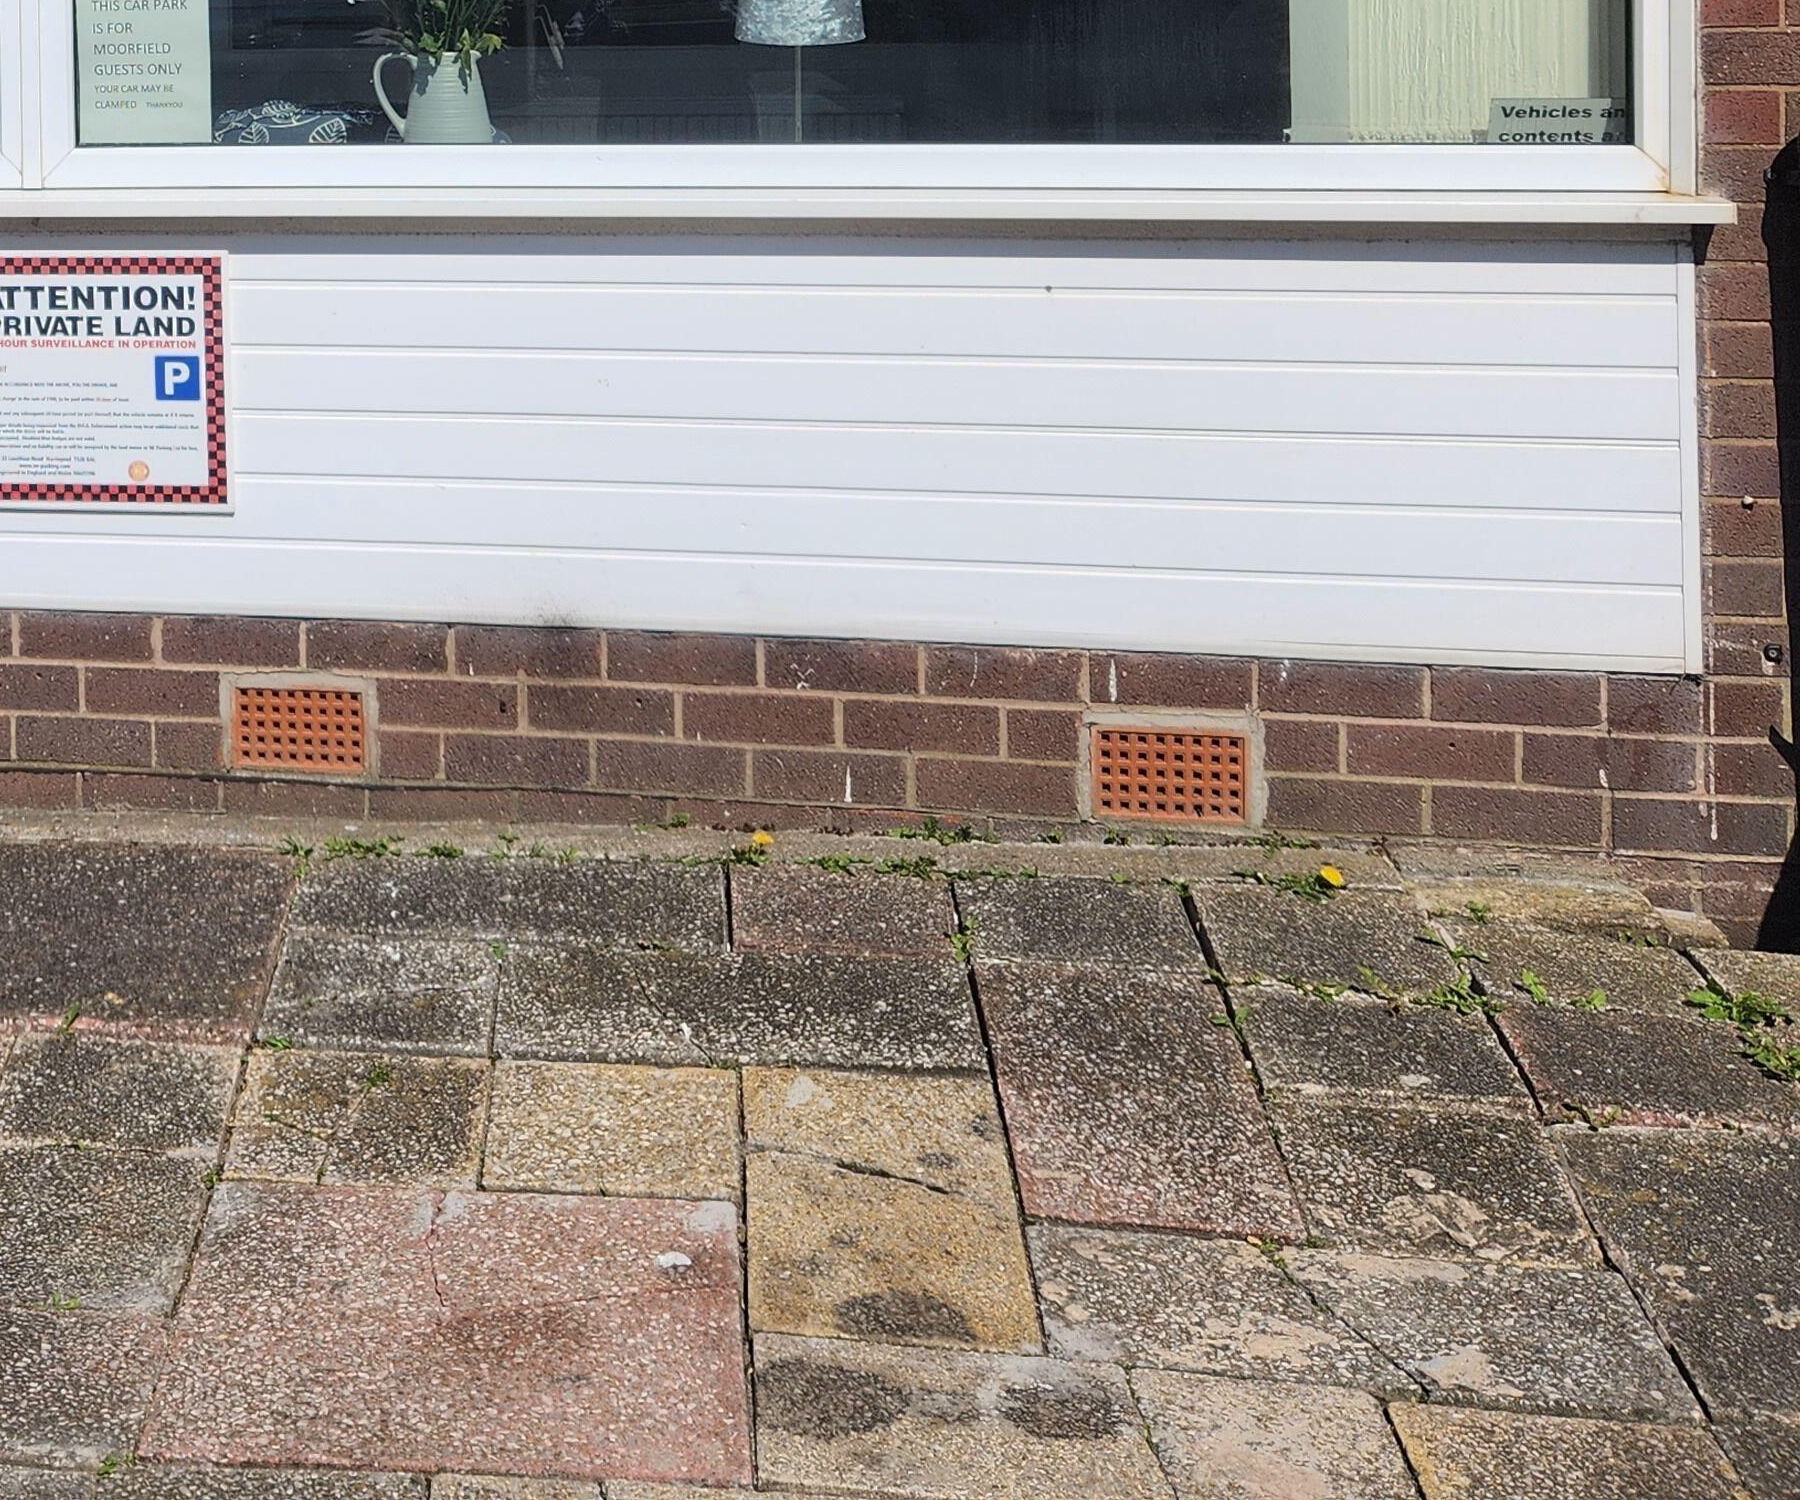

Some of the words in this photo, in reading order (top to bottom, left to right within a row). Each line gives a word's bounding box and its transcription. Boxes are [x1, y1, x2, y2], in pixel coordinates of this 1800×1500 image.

[91, 0, 120, 12] THIS
[123, 0, 150, 11] CAR
[92, 23, 104, 34] IS
[107, 22, 133, 34] FOR
[93, 43, 171, 55] MOORFIELD
[94, 64, 144, 76] GUESTS
[147, 63, 183, 76] ONLY
[94, 84, 119, 94] YOUR
[121, 84, 139, 93] CAR
[141, 84, 162, 93] MAY
[163, 84, 174, 93] BE
[94, 100, 137, 109] CLAMPED
[1501, 105, 1593, 118] Vehicles
[1600, 107, 1625, 118] an
[1498, 130, 1594, 143] contents
[114, 316, 196, 337] LAND
[31, 339, 114, 349] SURVEILLANCE
[118, 340, 128, 349] IN
[133, 340, 196, 349] OPERATION
[164, 361, 190, 395] P
